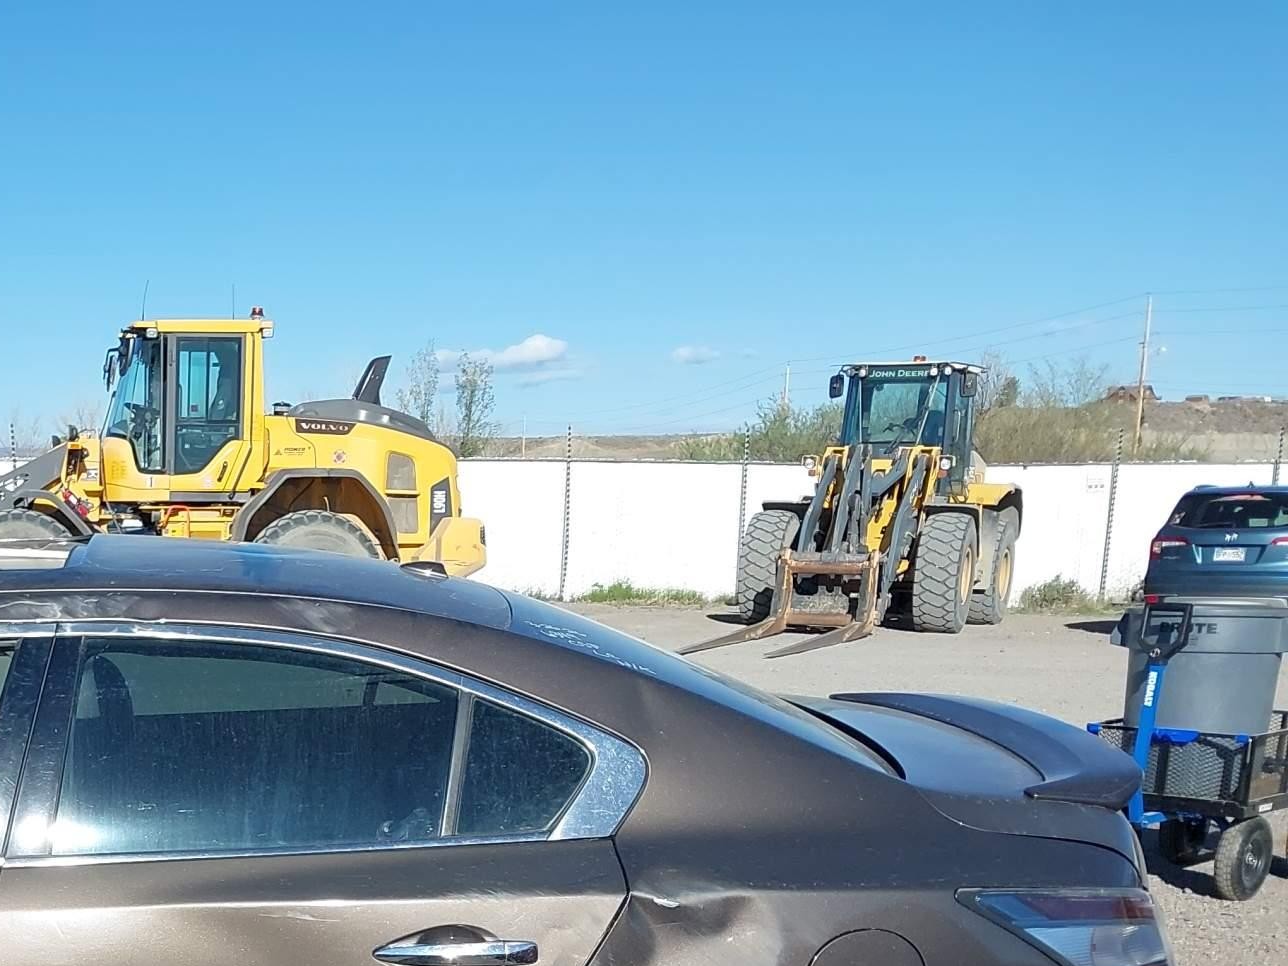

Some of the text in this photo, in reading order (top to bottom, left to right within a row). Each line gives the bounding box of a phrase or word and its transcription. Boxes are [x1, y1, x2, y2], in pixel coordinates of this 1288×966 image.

[869, 369, 896, 378] JOHN
[299, 422, 349, 432] VOLVO
[432, 490, 446, 513] L90H
[1159, 621, 1217, 634] BRTE
[1143, 670, 1159, 707] KOBALT
